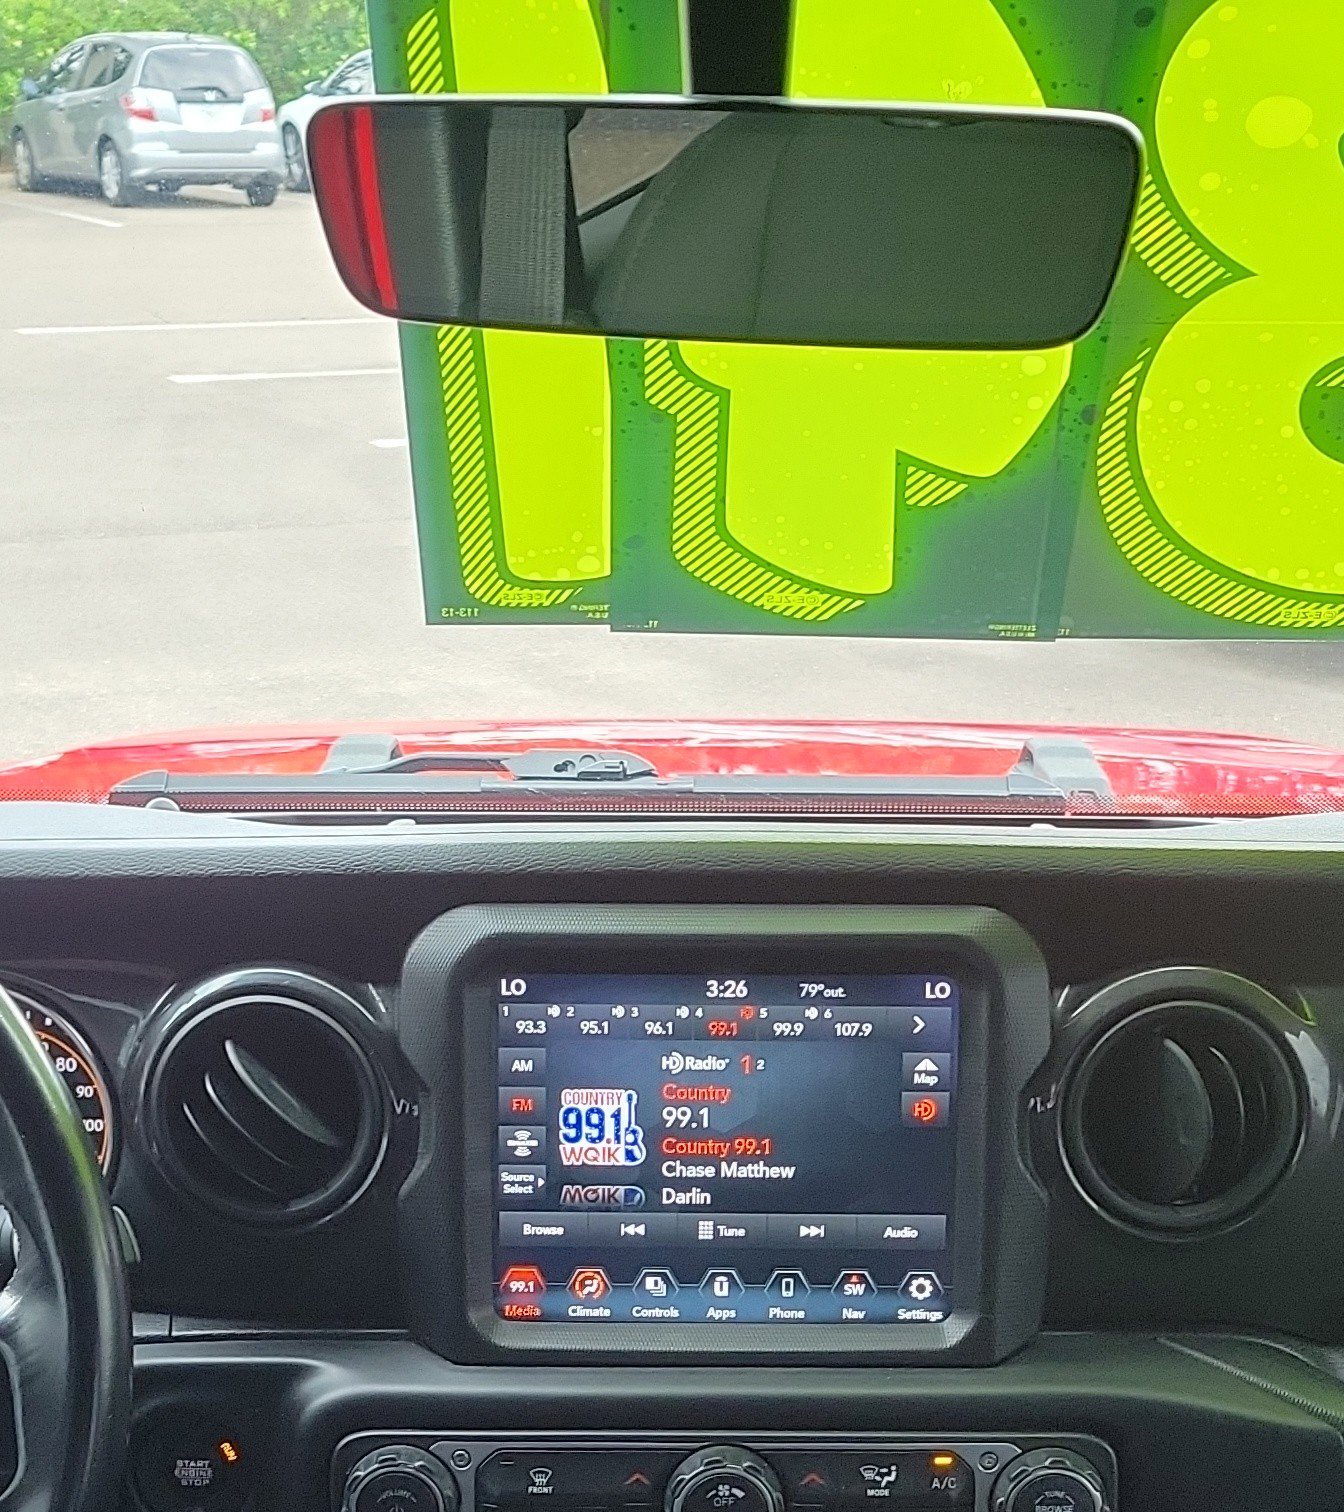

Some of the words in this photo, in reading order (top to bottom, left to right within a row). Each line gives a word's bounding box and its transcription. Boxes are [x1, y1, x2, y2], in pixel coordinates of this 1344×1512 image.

[500, 978, 527, 996] LO
[706, 980, 748, 998] 3:26
[925, 982, 951, 998] LO
[502, 1006, 509, 1017] 1
[566, 1007, 575, 1018] 2
[631, 1007, 639, 1018] 3
[694, 1007, 703, 1018] 4
[759, 1008, 768, 1019] 5
[823, 1008, 833, 1019] 6
[515, 1020, 547, 1035] 93.3
[580, 1020, 610, 1035] 95.1
[644, 1021, 674, 1036] 96.1
[708, 1021, 738, 1037] 99.1
[772, 1022, 804, 1037] 99.9
[834, 1022, 873, 1037] 107.9
[55, 1056, 78, 1073] 80
[511, 1060, 533, 1073] AM
[756, 1059, 765, 1071] 2
[913, 1072, 939, 1087] Map
[75, 1084, 95, 1099] 90
[563, 1091, 623, 1106] COUNTRY
[662, 1084, 731, 1103] Country
[511, 1098, 534, 1113] FM
[562, 1106, 623, 1145] 99.1
[662, 1106, 711, 1130] 99.1
[562, 1146, 623, 1163] WQIK
[662, 1139, 731, 1158] Country
[734, 1138, 772, 1156] 99.1
[501, 1172, 535, 1184] Source
[662, 1161, 717, 1179] Chase
[721, 1161, 796, 1180] Matthew
[503, 1183, 534, 1195] Select
[662, 1187, 712, 1205] Darlin
[523, 1223, 565, 1236] Browse
[717, 1225, 747, 1238] Tune
[884, 1226, 919, 1240] Audio
[509, 1281, 535, 1294] 99.1
[843, 1283, 867, 1297] SW
[504, 1304, 542, 1319] Media
[568, 1305, 611, 1318] Climate
[632, 1305, 680, 1319] Controls
[706, 1306, 737, 1321] Apps
[768, 1307, 806, 1320] Phone
[842, 1307, 867, 1321] Nav
[897, 1307, 944, 1322] Settings
[176, 1459, 210, 1468] START
[528, 1486, 554, 1495] FRONT
[931, 1477, 957, 1490] A/C
[867, 1488, 890, 1497] MODE
[713, 1497, 735, 1507] OFF
